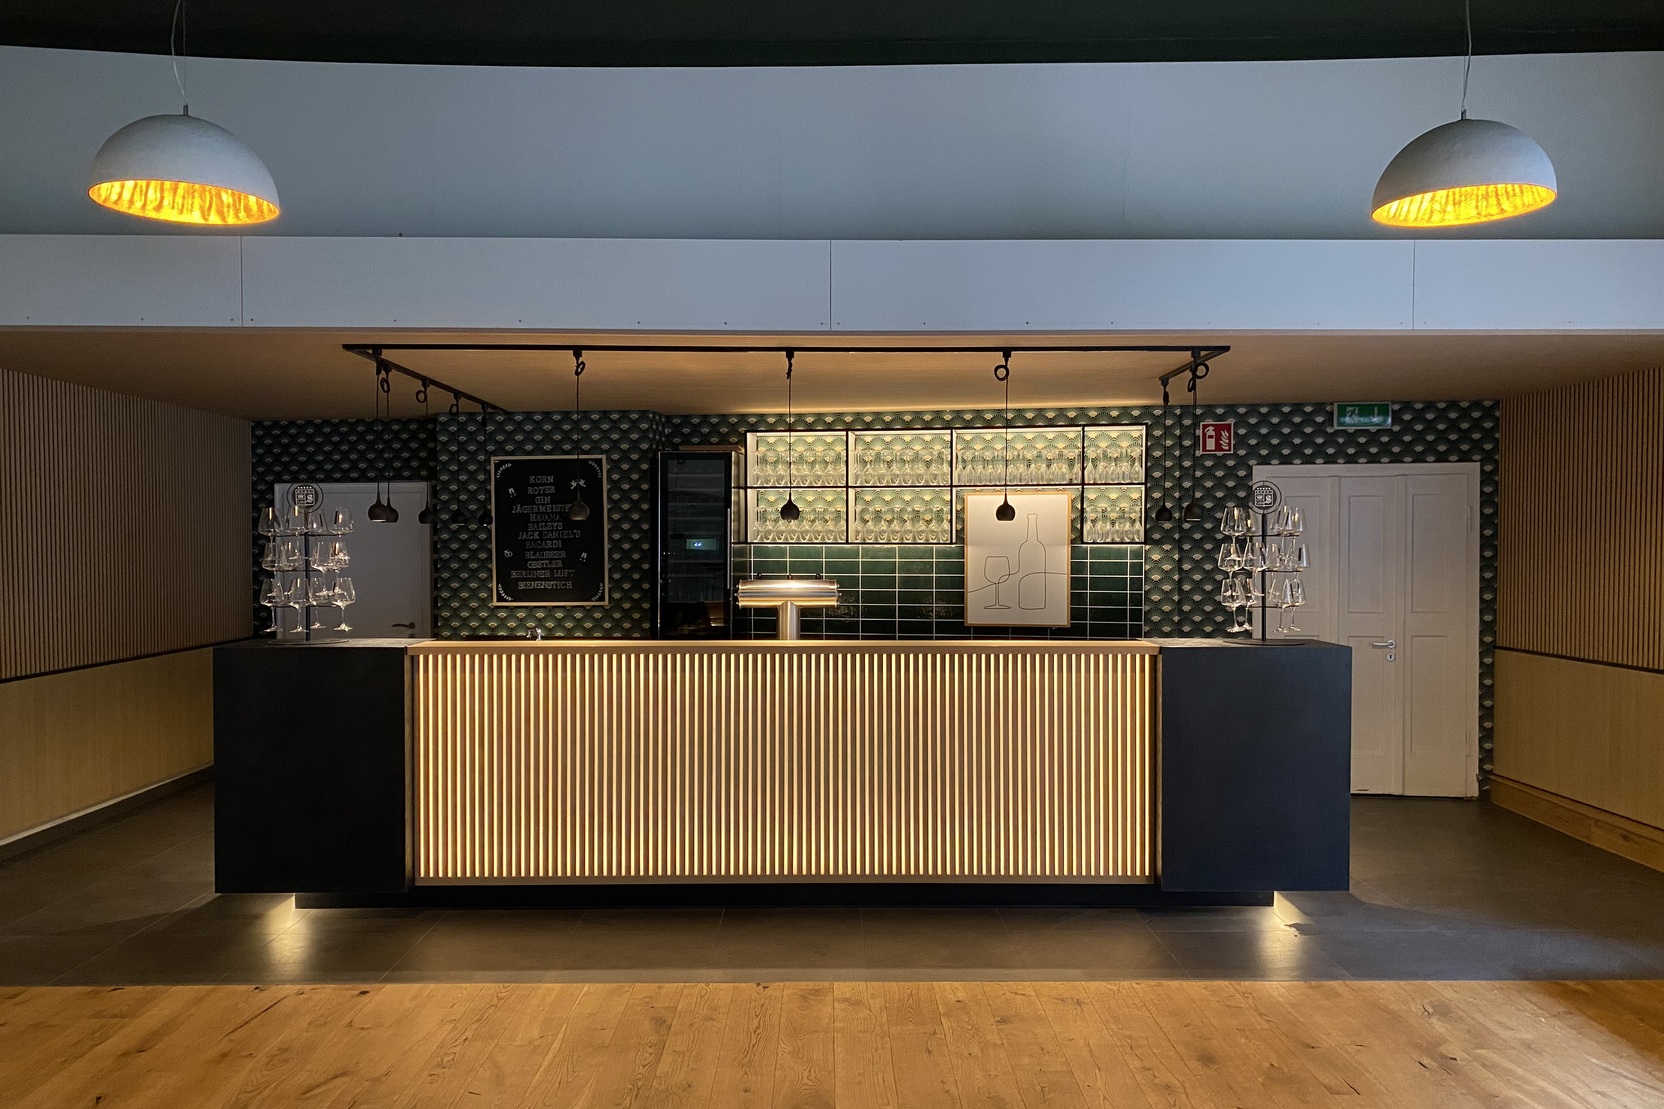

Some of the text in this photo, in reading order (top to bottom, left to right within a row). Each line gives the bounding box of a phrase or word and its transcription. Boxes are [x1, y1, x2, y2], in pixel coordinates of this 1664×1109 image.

[529, 476, 554, 484] KORN
[527, 486, 556, 495] ROTER
[535, 496, 551, 504] GIN
[512, 504, 572, 513] JÄGERMEISTE
[528, 522, 563, 531] BAILEYS
[518, 530, 580, 540] JACK DANIEL'S
[525, 540, 562, 549] BACARDI
[525, 550, 567, 559] BLAUBEER
[527, 560, 563, 569] OBSTLER
[510, 569, 576, 578] BERLINER LUFT
[517, 581, 573, 590] BIENENSTICH
